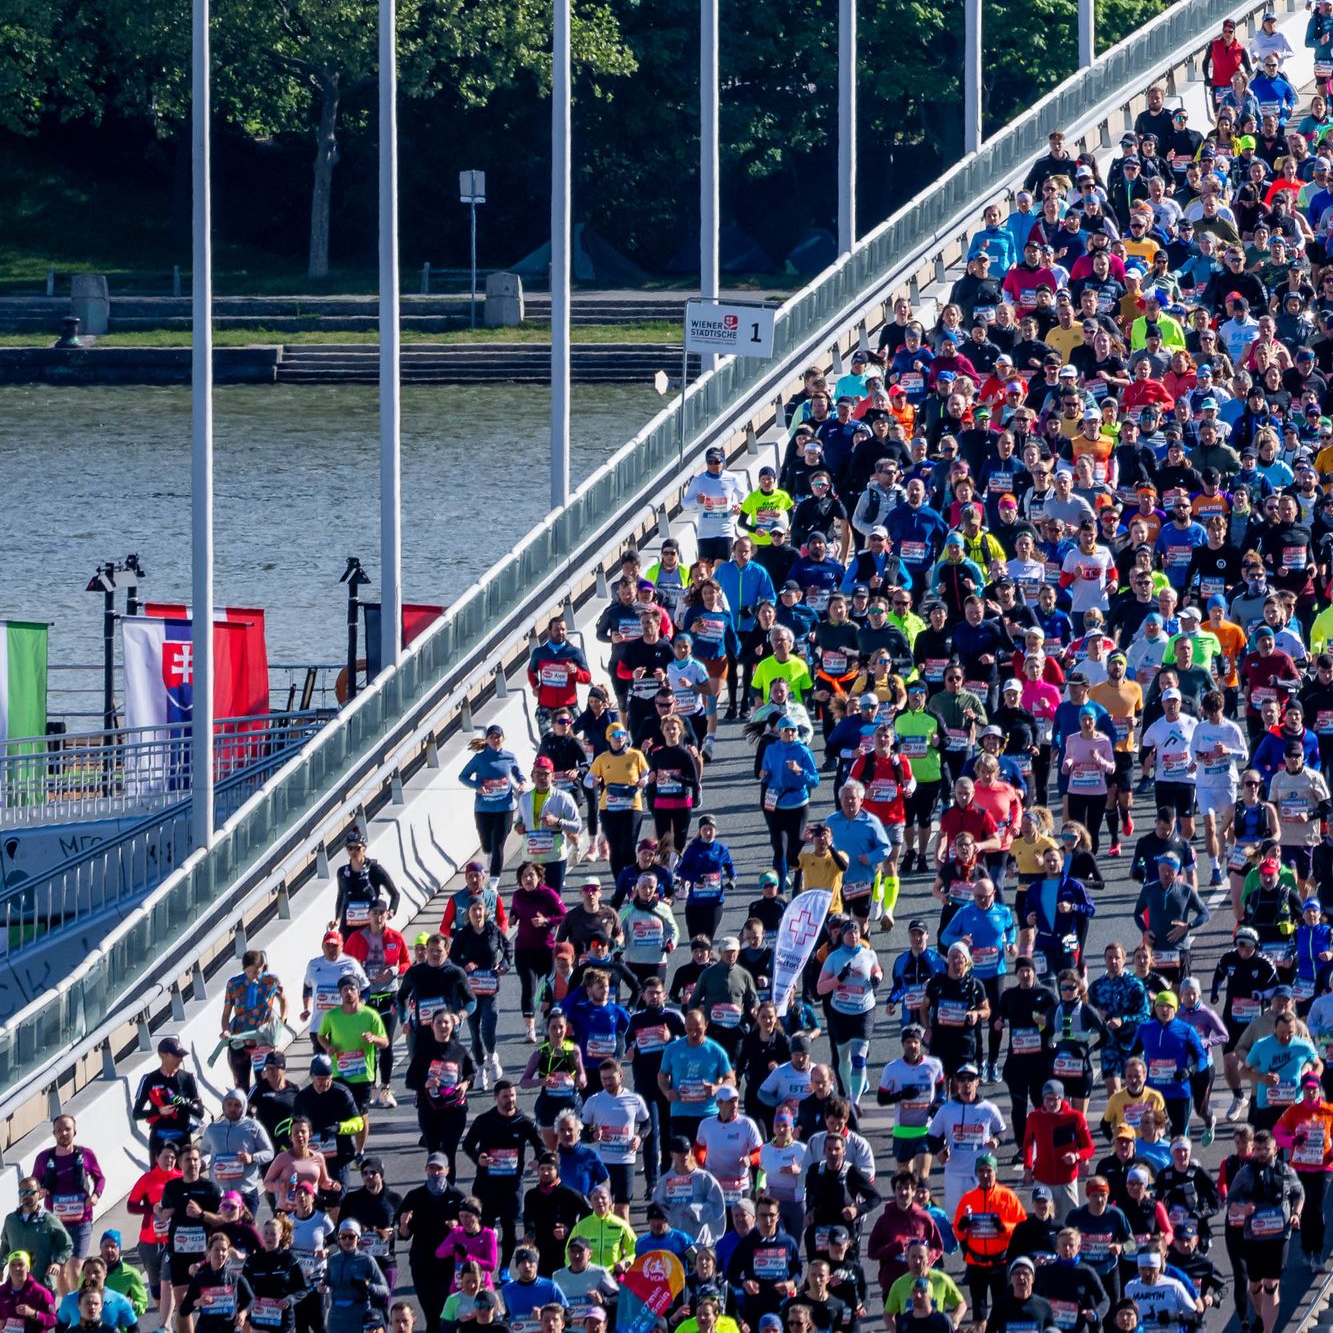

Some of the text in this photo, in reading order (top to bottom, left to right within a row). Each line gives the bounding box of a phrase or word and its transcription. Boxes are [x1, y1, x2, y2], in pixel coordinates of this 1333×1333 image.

[691, 319, 723, 330] WIENER
[750, 322, 762, 343] 1
[1132, 1290, 1164, 1301] MARTIN
